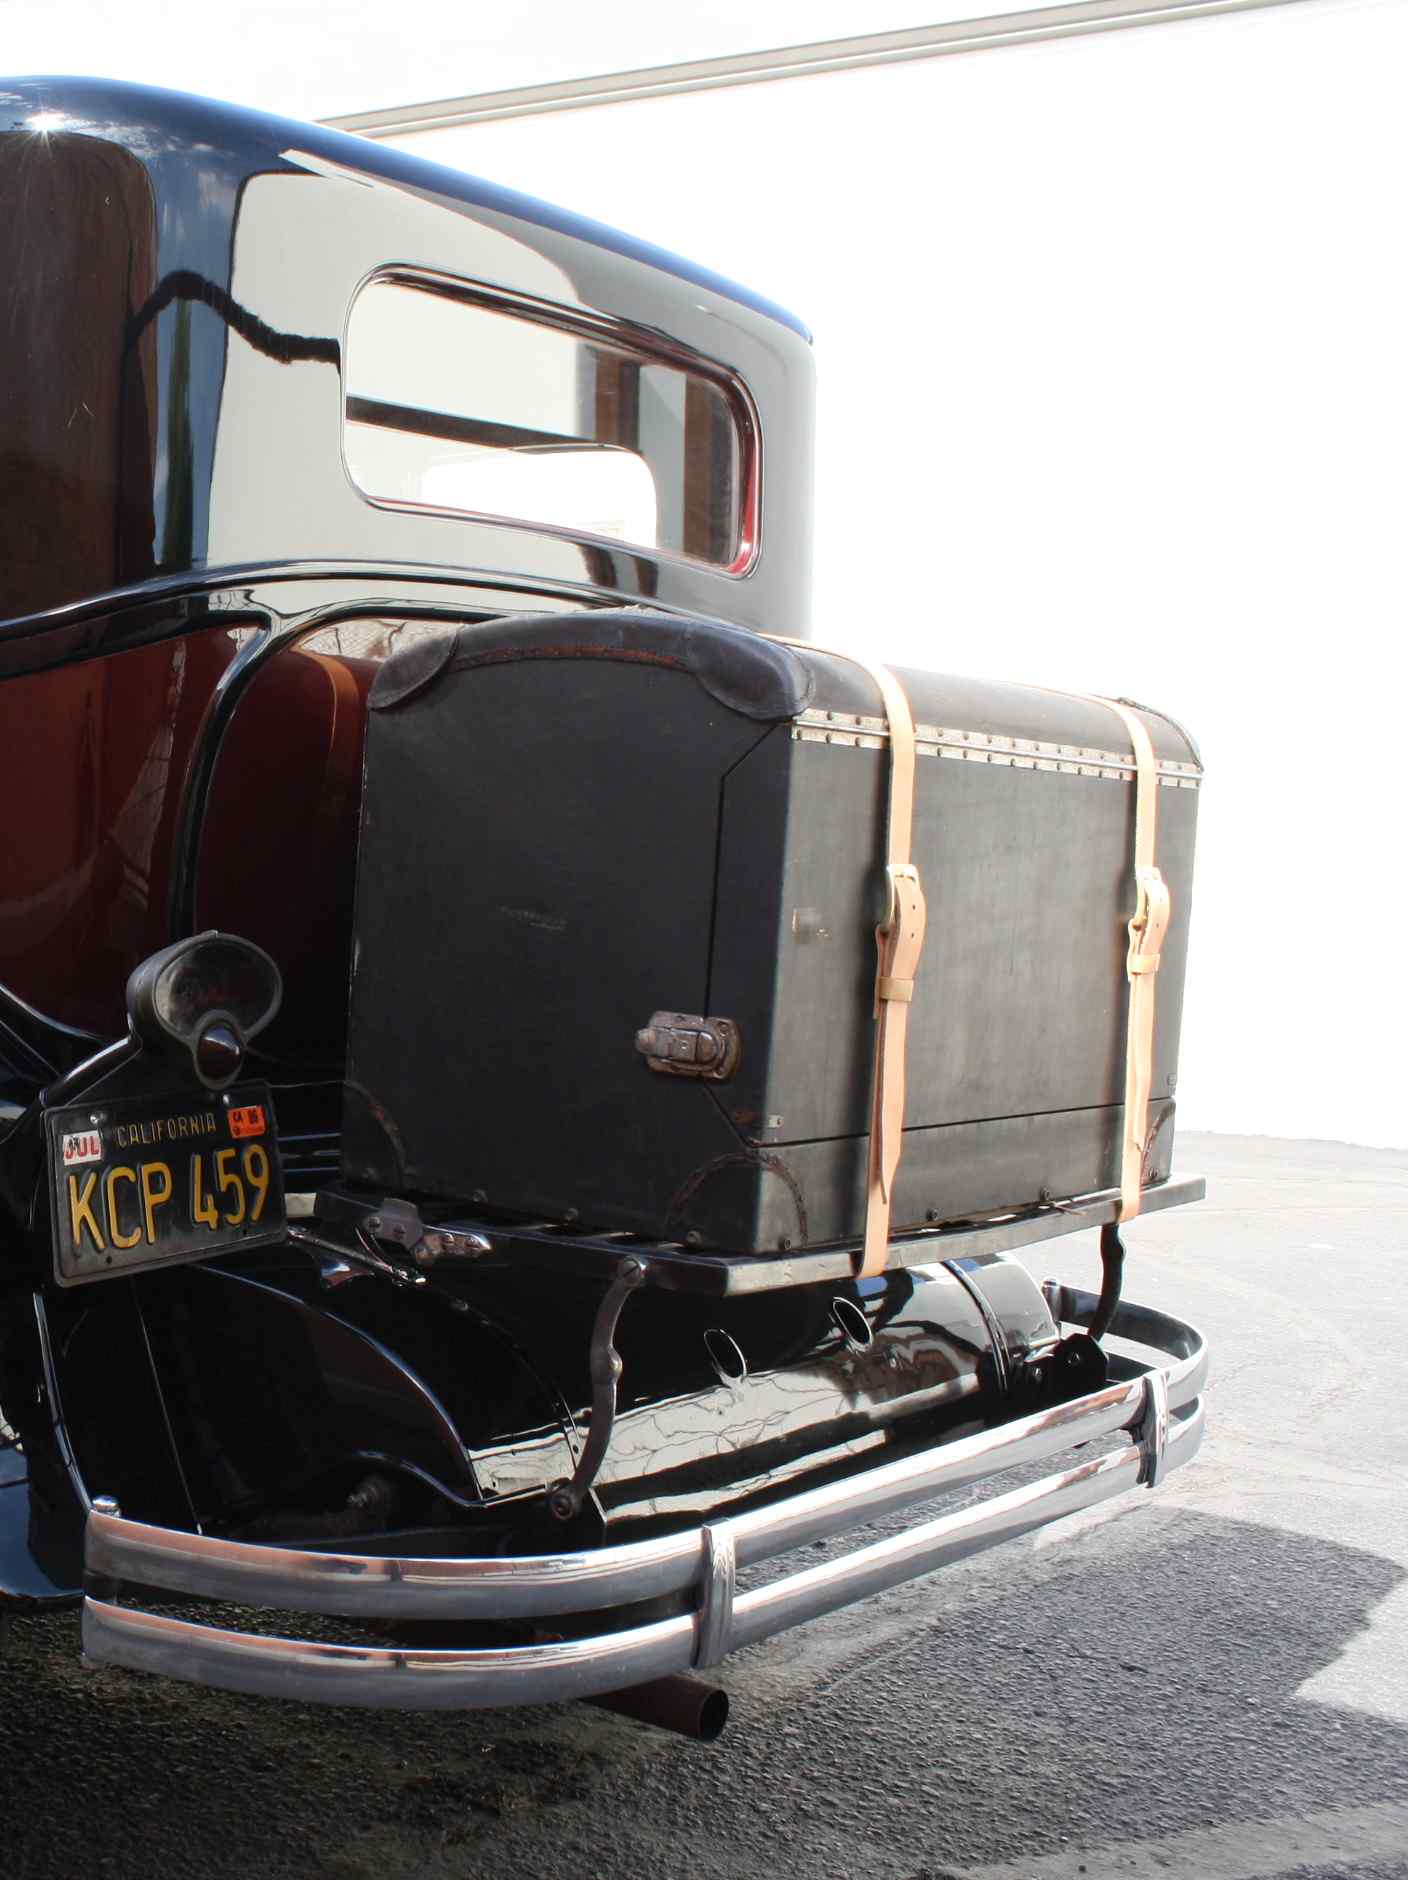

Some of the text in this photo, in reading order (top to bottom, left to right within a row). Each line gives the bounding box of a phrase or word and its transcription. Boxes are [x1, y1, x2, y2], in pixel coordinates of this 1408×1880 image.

[117, 1112, 216, 1148] CALIFORNIA
[69, 1144, 269, 1249] KCP 459
